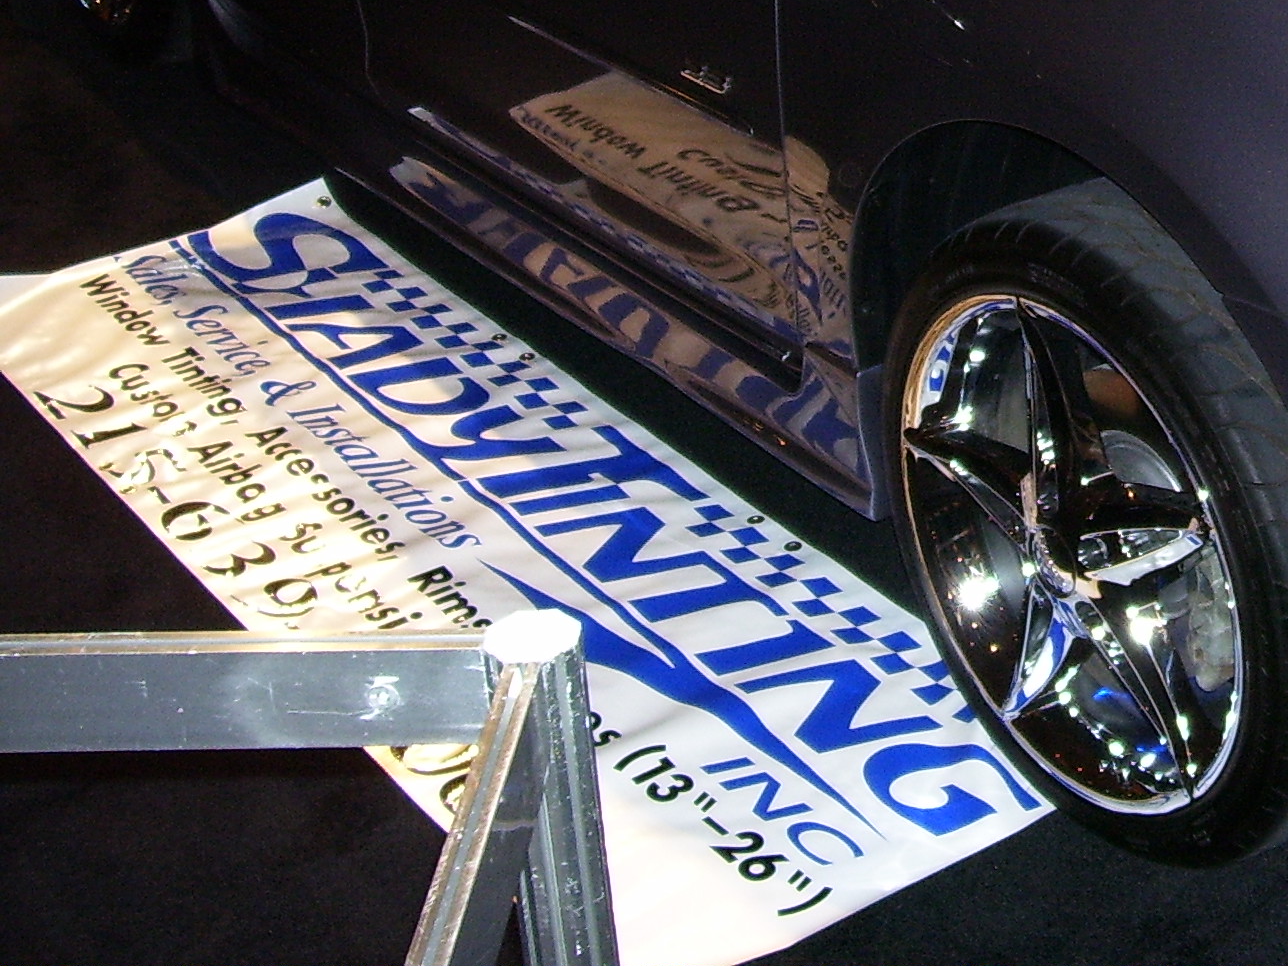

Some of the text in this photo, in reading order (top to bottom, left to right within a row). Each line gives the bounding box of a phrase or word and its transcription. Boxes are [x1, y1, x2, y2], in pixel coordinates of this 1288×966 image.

[80, 273, 171, 346] Window
[259, 379, 317, 407] &
[287, 403, 483, 549] Installations
[699, 757, 864, 866] INC
